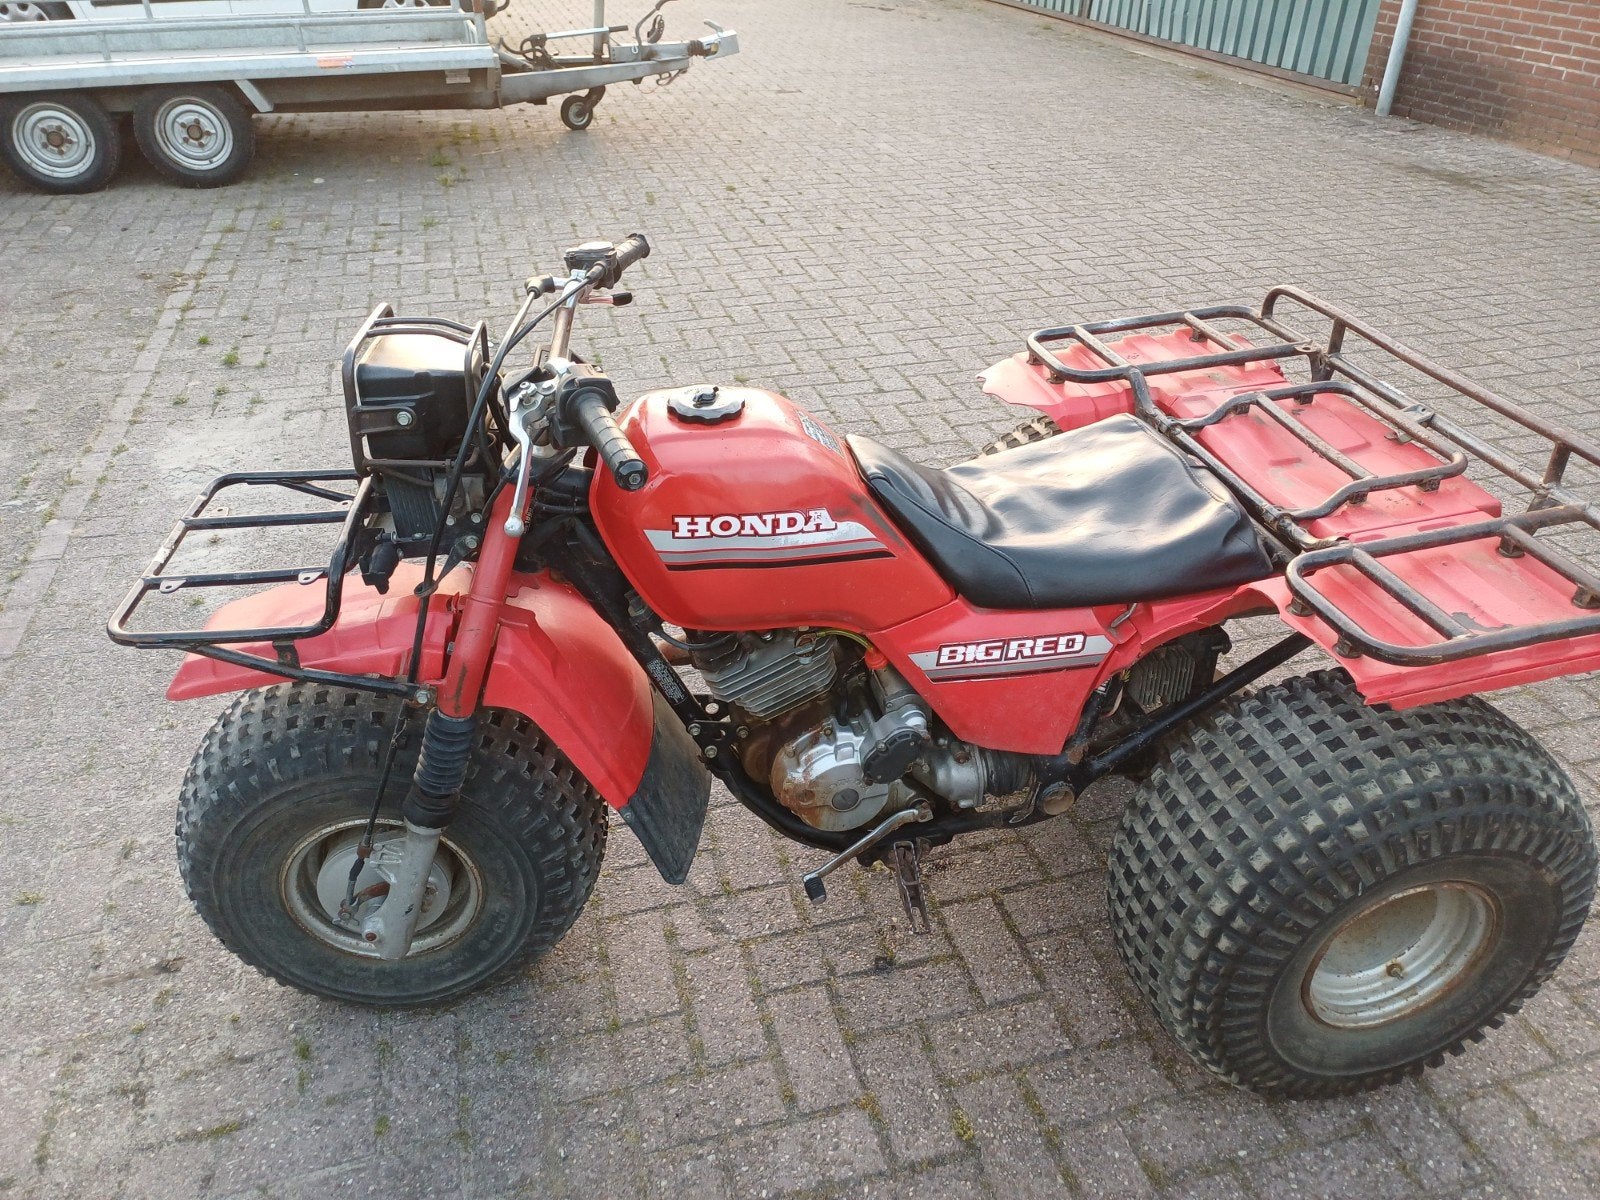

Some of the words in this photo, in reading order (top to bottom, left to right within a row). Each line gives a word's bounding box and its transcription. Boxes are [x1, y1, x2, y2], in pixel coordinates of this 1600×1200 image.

[673, 507, 837, 539] HONDA
[938, 642, 1004, 665] BIG
[1007, 633, 1085, 659] RED
